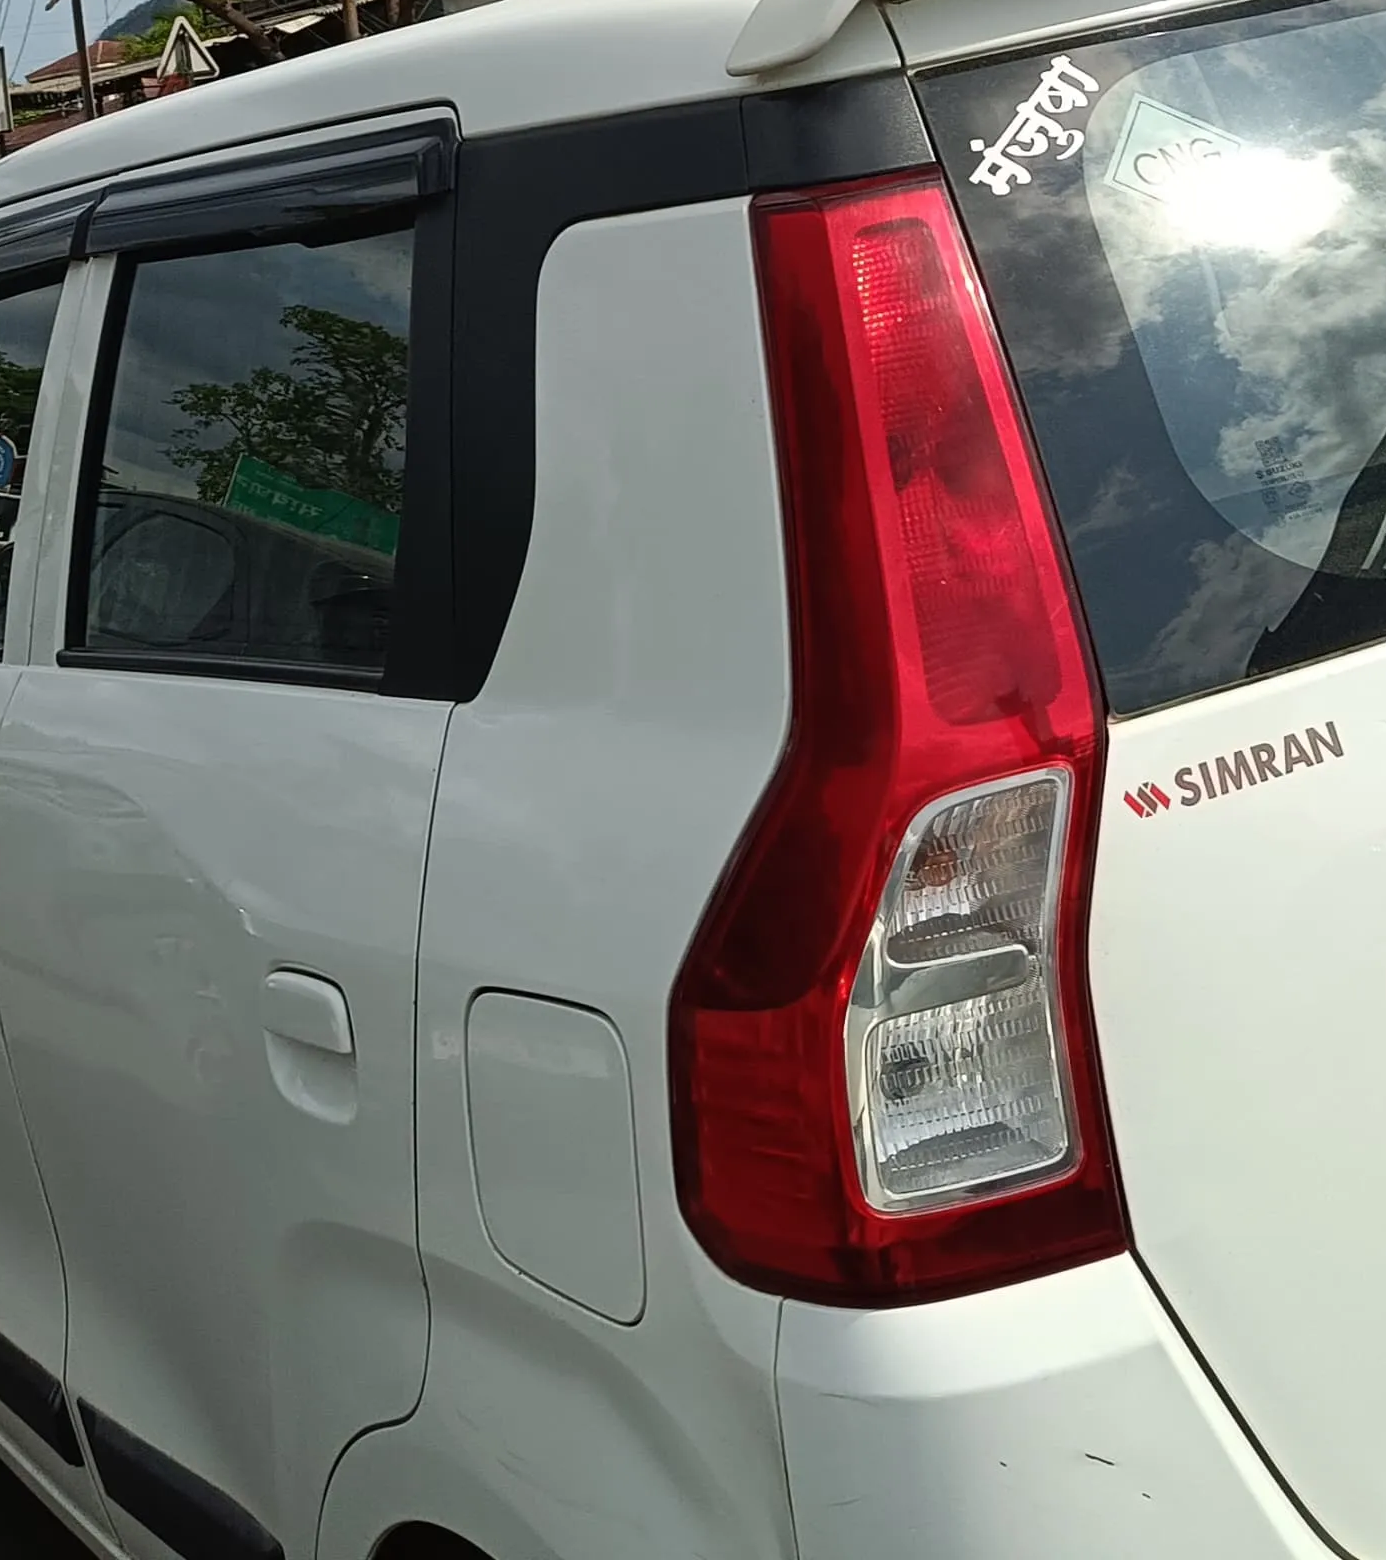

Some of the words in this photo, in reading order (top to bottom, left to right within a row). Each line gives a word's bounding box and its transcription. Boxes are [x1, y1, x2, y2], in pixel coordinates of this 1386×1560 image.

[969, 55, 1100, 195] मंजुषा
[1133, 137, 1222, 186] CNG
[1174, 721, 1344, 807] SIMRAN
